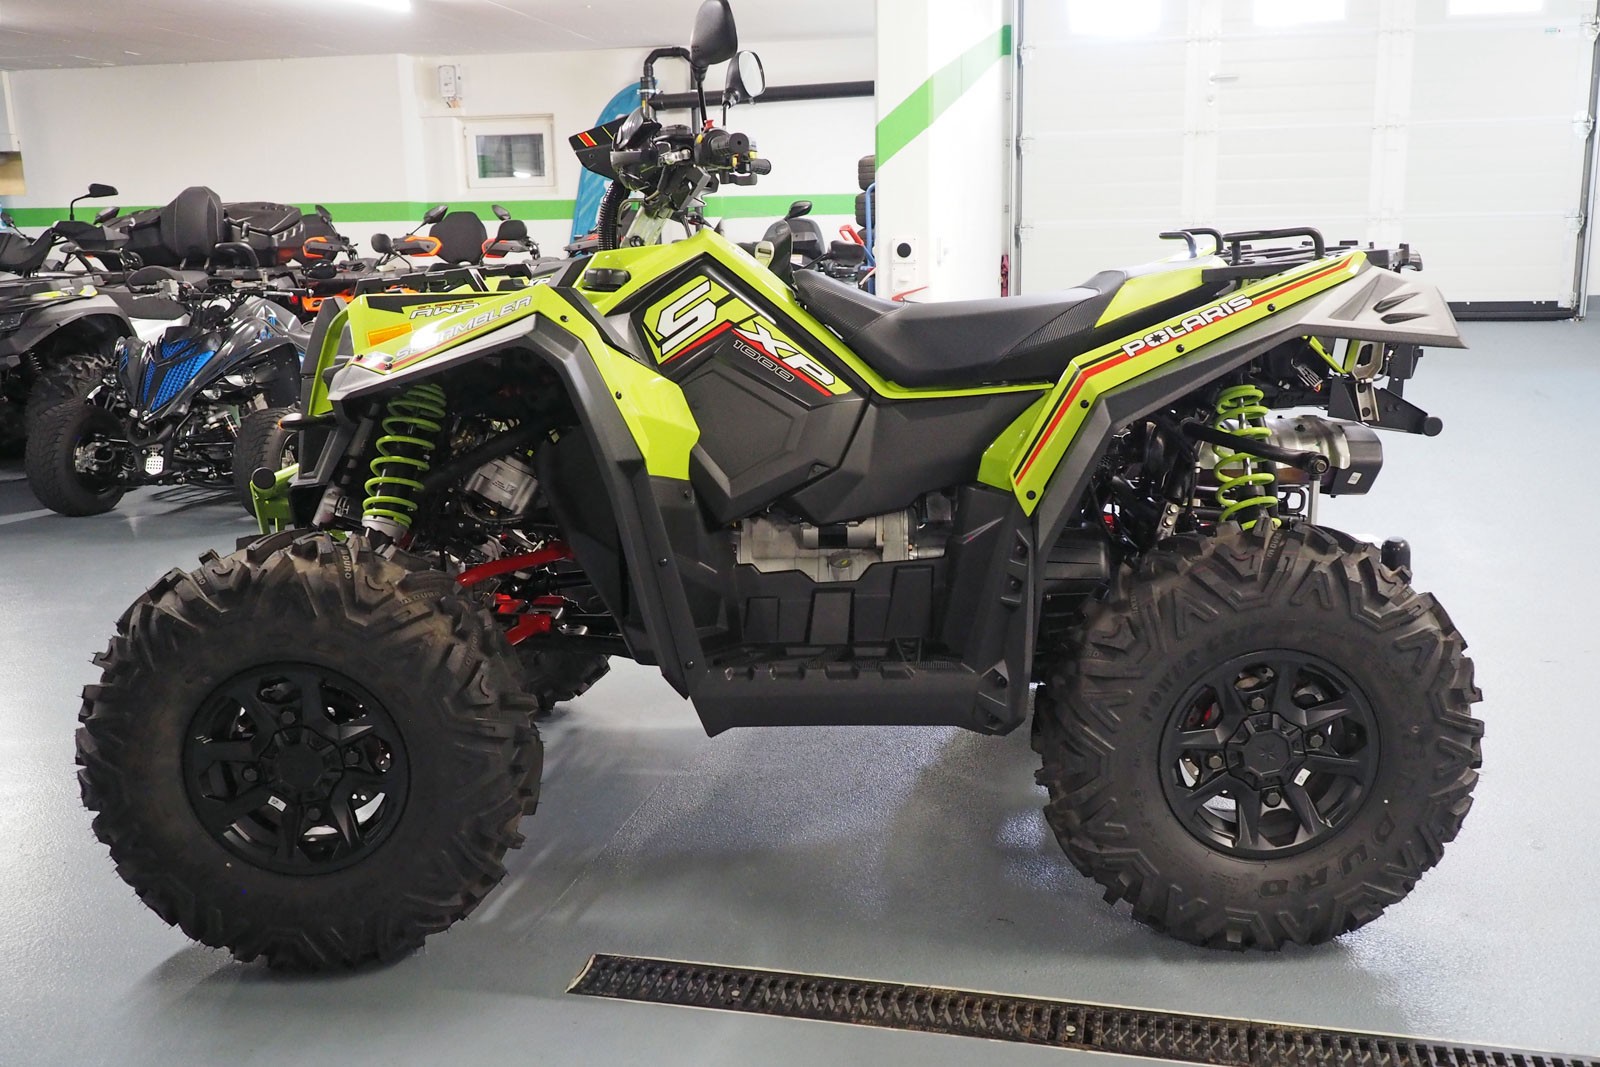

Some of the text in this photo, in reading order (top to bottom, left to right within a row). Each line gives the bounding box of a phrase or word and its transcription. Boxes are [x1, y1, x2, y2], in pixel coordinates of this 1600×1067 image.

[394, 295, 533, 360] SAMBLER
[409, 302, 480, 319] AWD
[1121, 294, 1253, 358] POLARIS
[732, 319, 836, 387] XP
[733, 339, 795, 383] 1000
[342, 555, 352, 580] DURO
